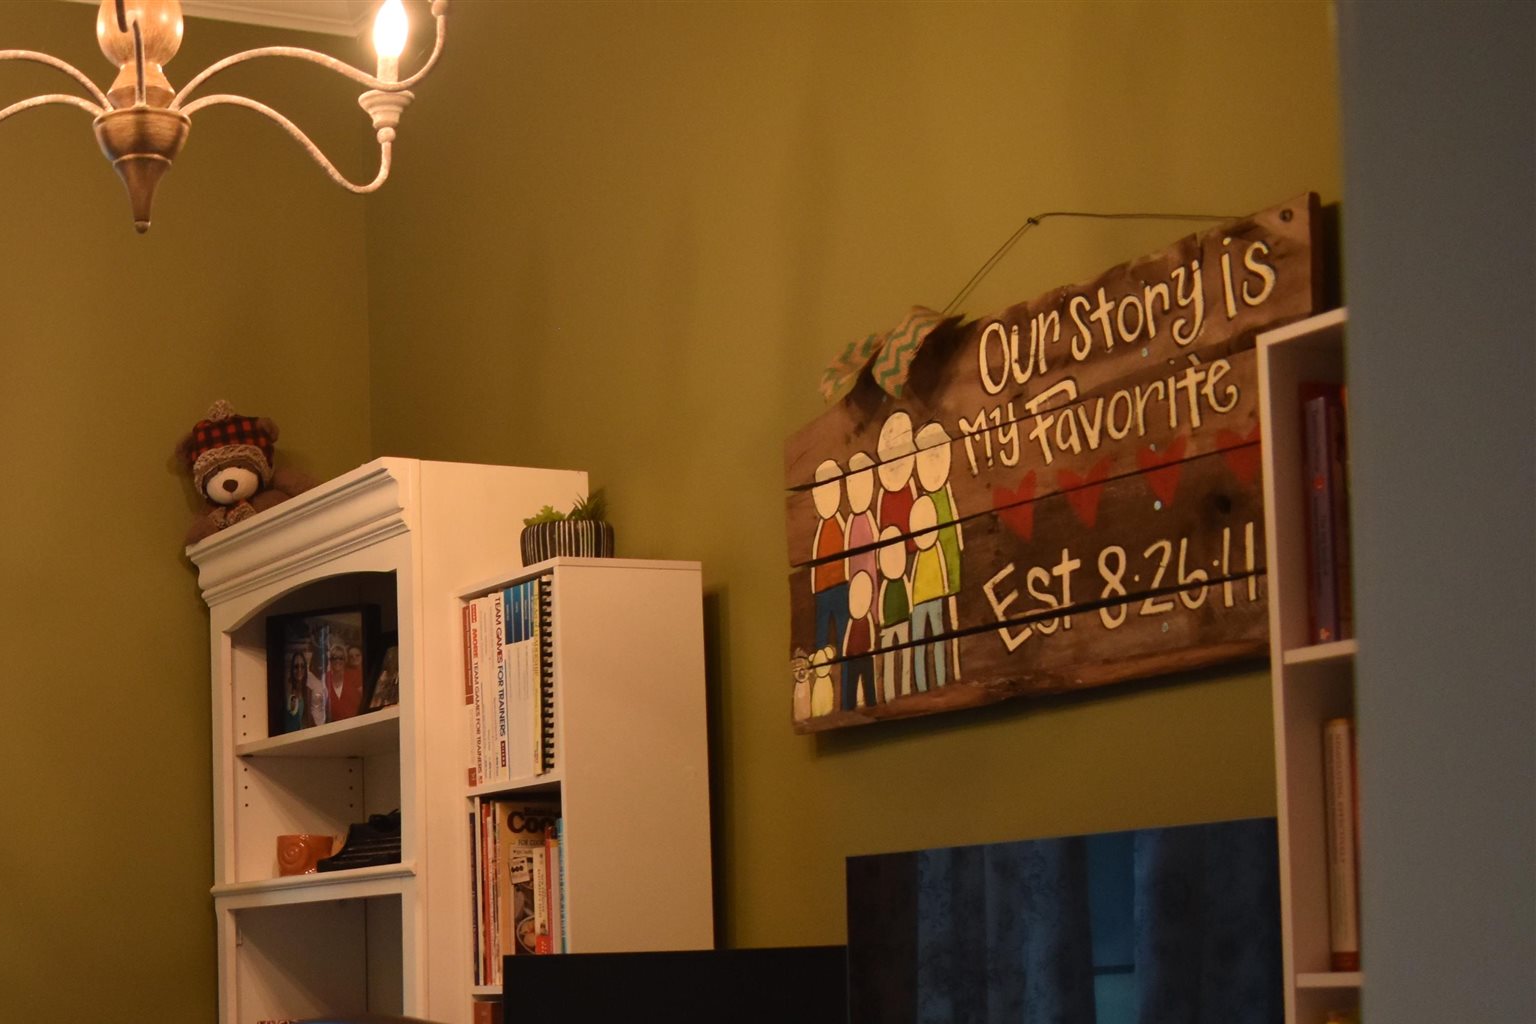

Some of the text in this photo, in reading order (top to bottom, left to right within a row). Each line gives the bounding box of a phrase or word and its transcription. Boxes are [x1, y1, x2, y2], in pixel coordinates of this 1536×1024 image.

[979, 310, 1060, 394] Our
[1221, 237, 1276, 319] is
[1025, 354, 1238, 465] Favorite
[983, 548, 1081, 651] Est
[498, 689, 506, 737] TRAINERS
